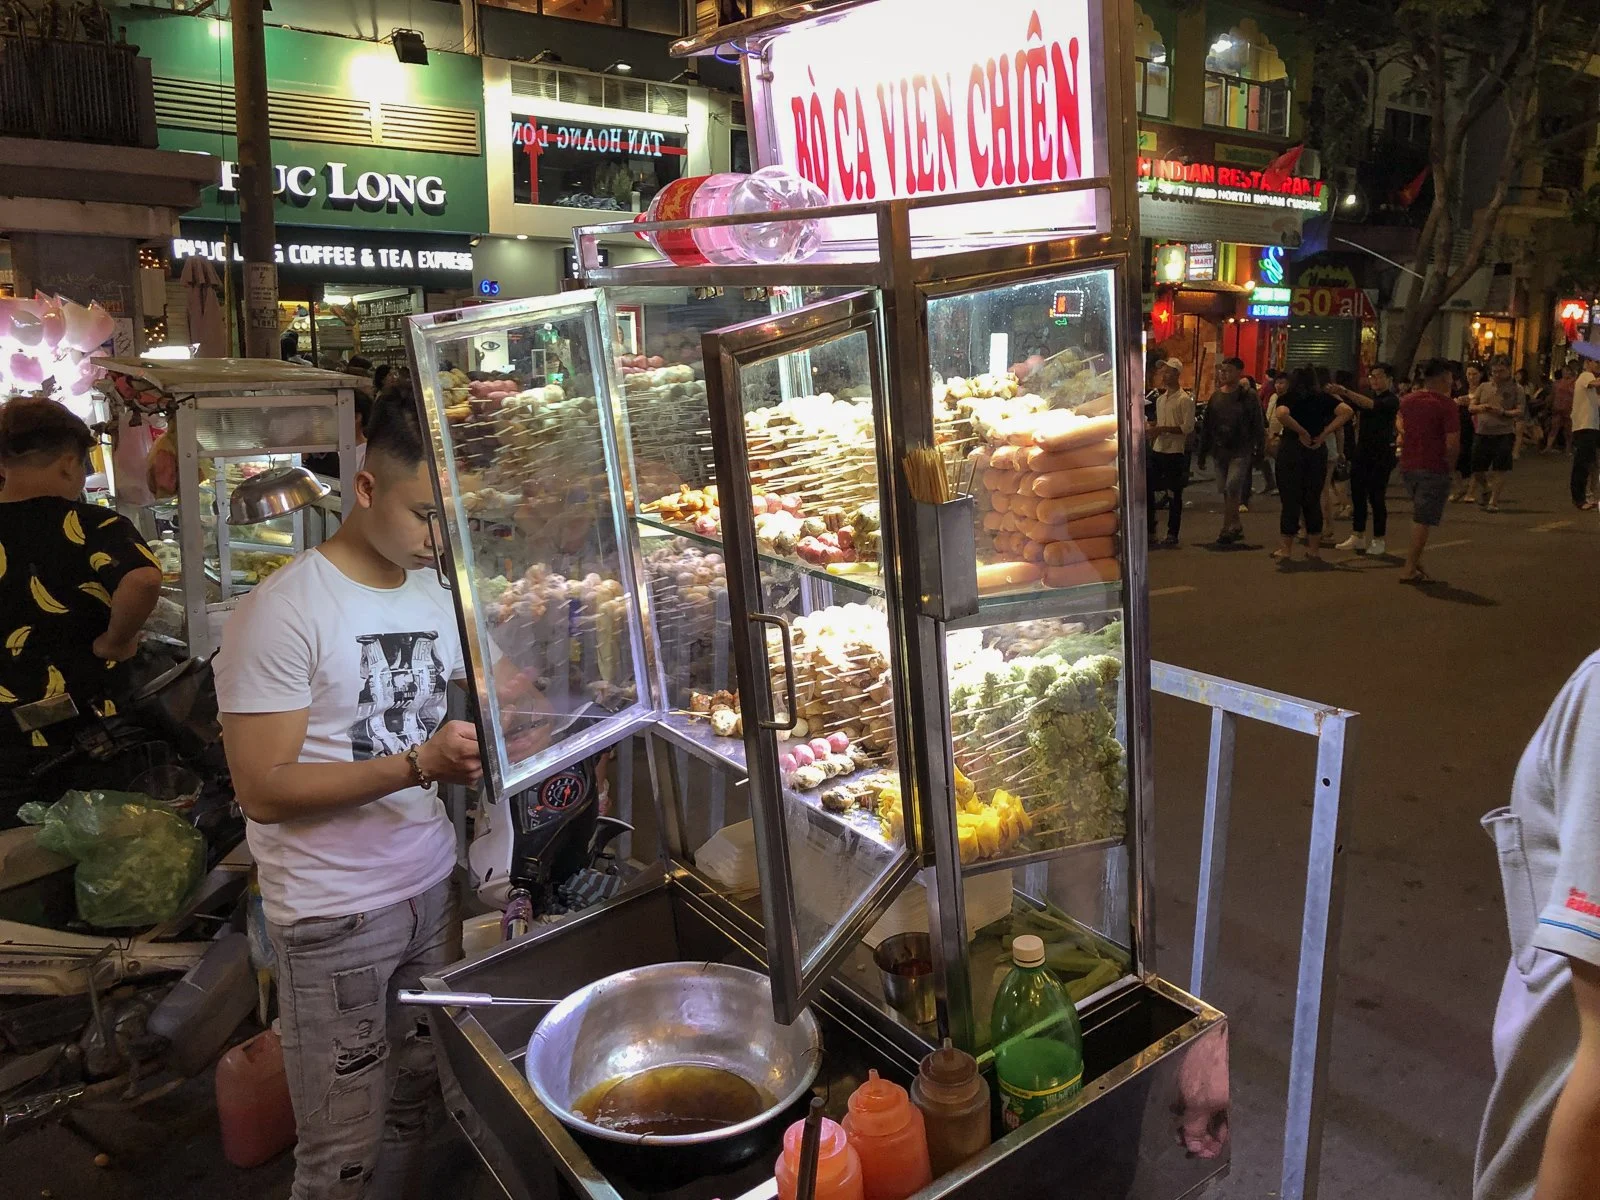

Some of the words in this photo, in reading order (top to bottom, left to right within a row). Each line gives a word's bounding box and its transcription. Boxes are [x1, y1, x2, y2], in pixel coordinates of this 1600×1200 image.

[967, 9, 1082, 188] CHIÊN
[327, 161, 447, 205] LONG
[1153, 159, 1214, 183] INDIAN
[1195, 187, 1217, 199] AND
[1218, 190, 1251, 203] NORTH
[1253, 194, 1285, 207] INDIAN
[289, 244, 355, 266] COFFEE
[361, 248, 375, 267] &
[379, 248, 413, 269] TEA
[418, 250, 474, 271] EXPRESS
[1340, 292, 1363, 317] all
